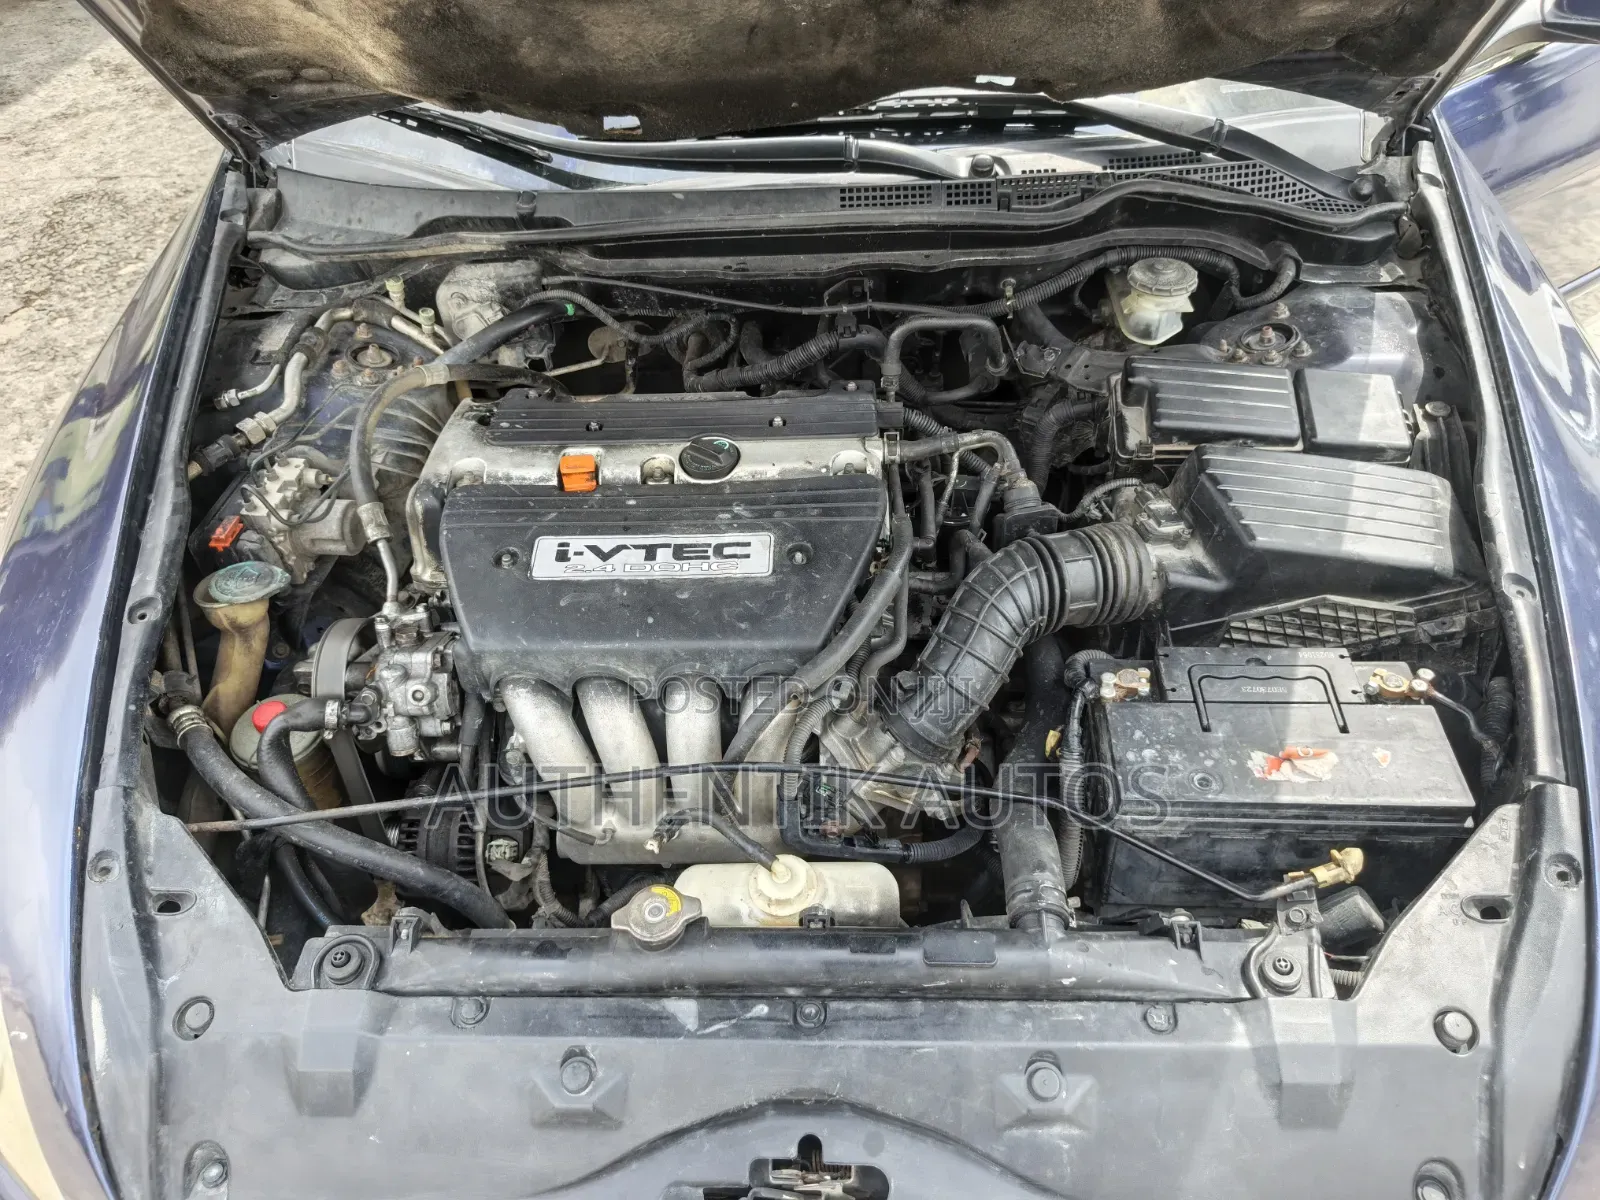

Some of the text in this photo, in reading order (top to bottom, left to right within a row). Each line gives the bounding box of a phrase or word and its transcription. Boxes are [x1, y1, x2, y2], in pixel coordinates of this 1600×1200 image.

[554, 541, 752, 563] i-VTEC
[563, 561, 739, 574] 2.4 DOHC
